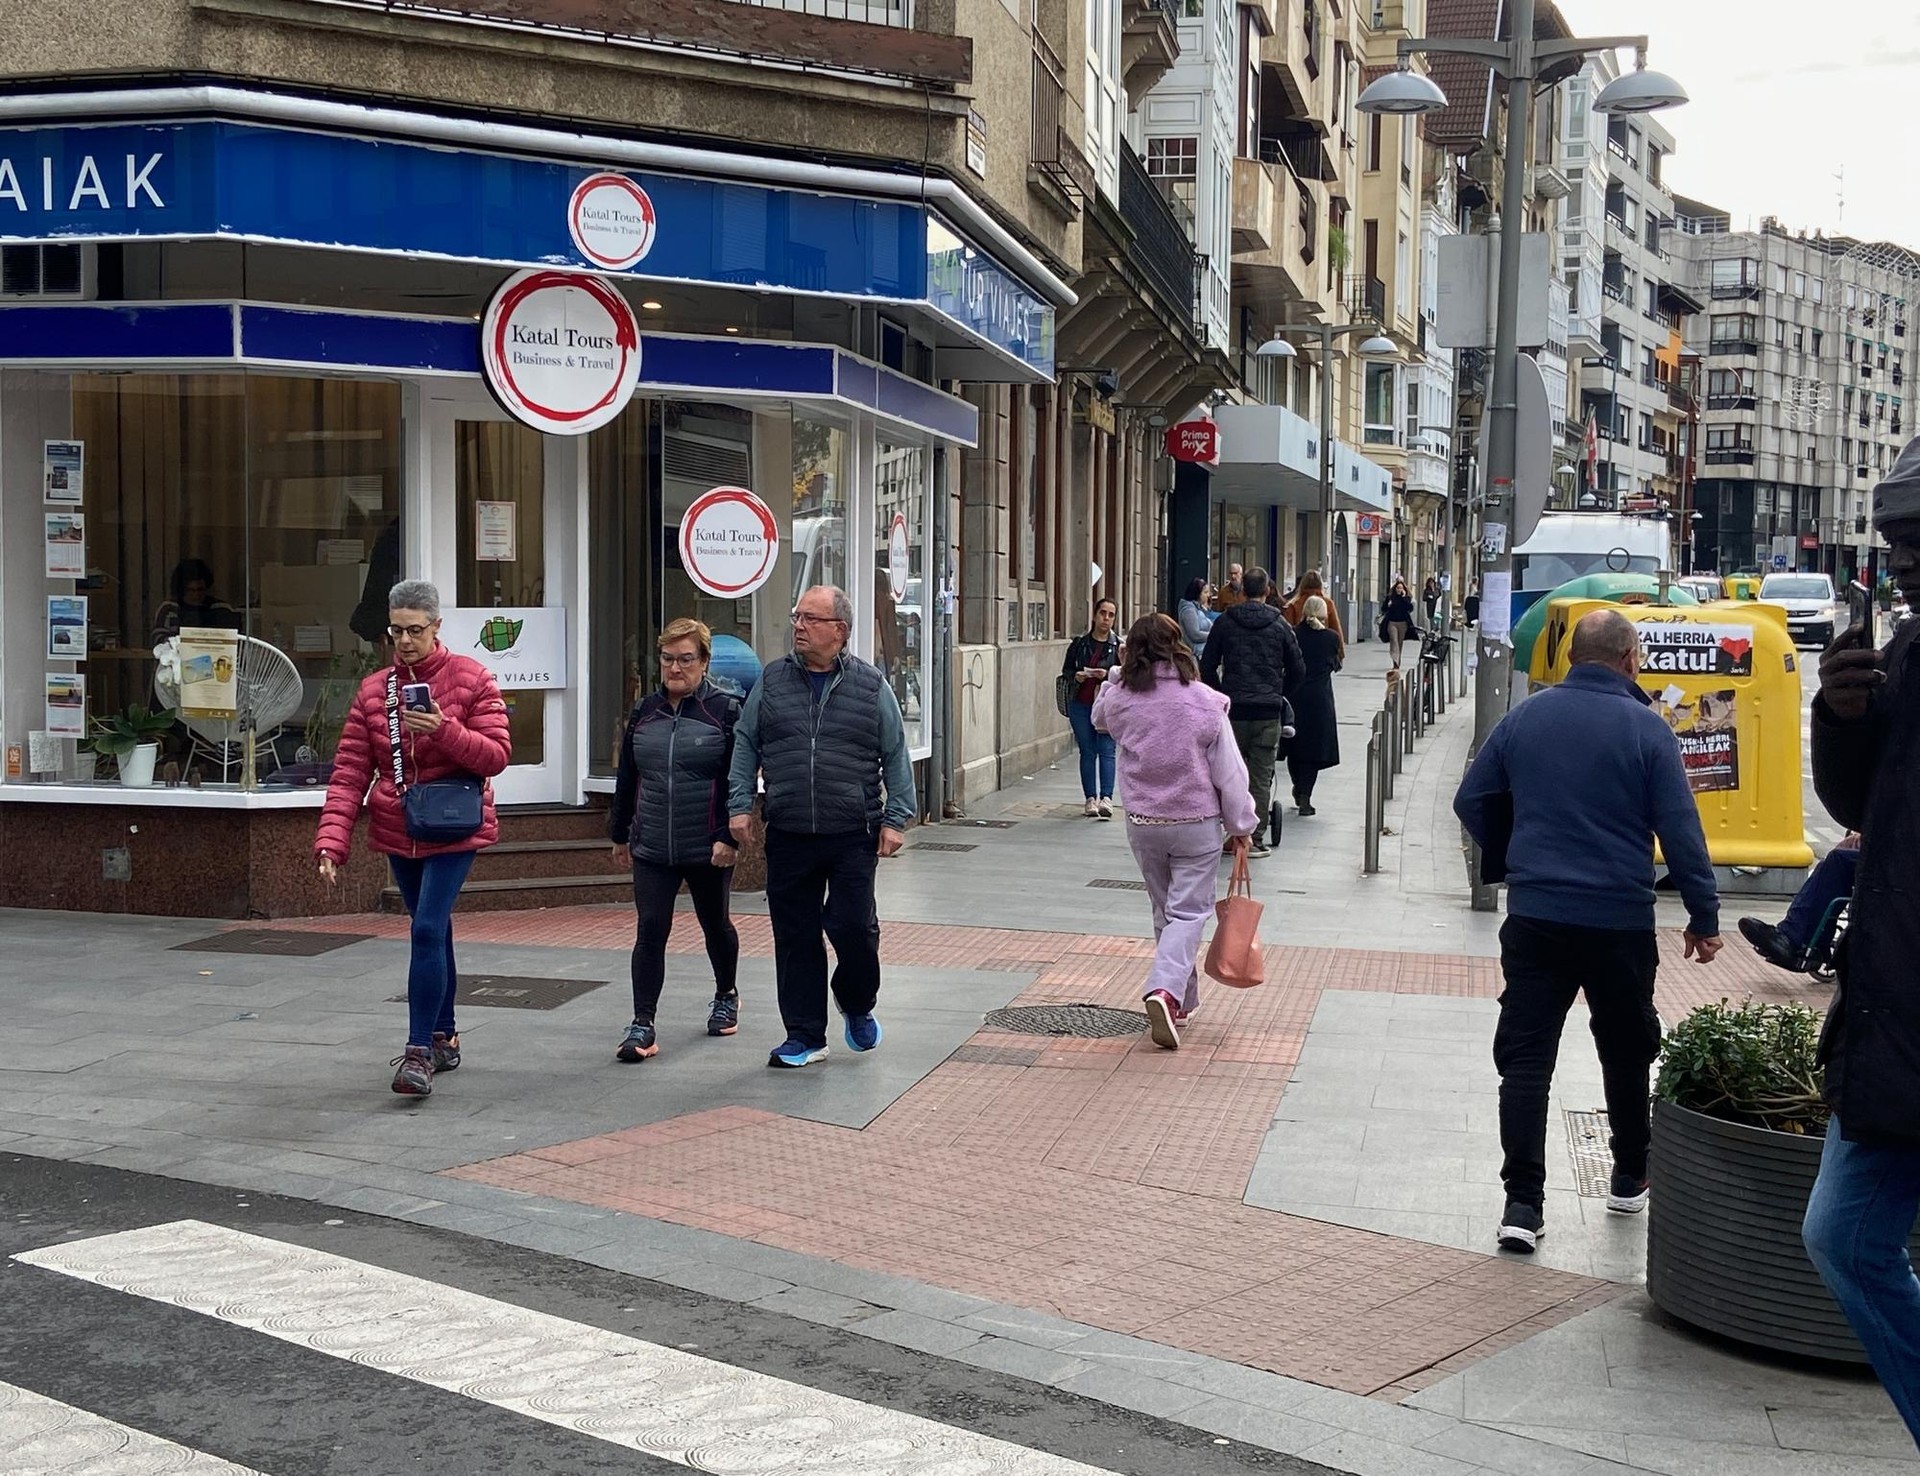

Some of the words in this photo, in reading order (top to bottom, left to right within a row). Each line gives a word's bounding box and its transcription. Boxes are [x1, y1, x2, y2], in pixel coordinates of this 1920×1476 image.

[583, 207, 609, 220] Katal
[612, 210, 641, 223] Tours
[990, 282, 1030, 346] VIAJES
[511, 324, 559, 346] Katal
[565, 329, 613, 350] Tours
[513, 351, 562, 367] Business
[565, 355, 576, 368] &
[578, 356, 614, 370] Travel
[1181, 430, 1210, 440] Prima
[695, 528, 726, 542] Katal
[729, 529, 762, 542] Tours
[696, 546, 728, 556] Business
[730, 547, 737, 556] &
[739, 547, 762, 557] Travel
[1663, 631, 1715, 645] HERRIA
[1641, 645, 1717, 671] katu!
[504, 672, 550, 682] VIAJES
[388, 709, 401, 745] BIMBA
[392, 749, 403, 784] BIMBA
